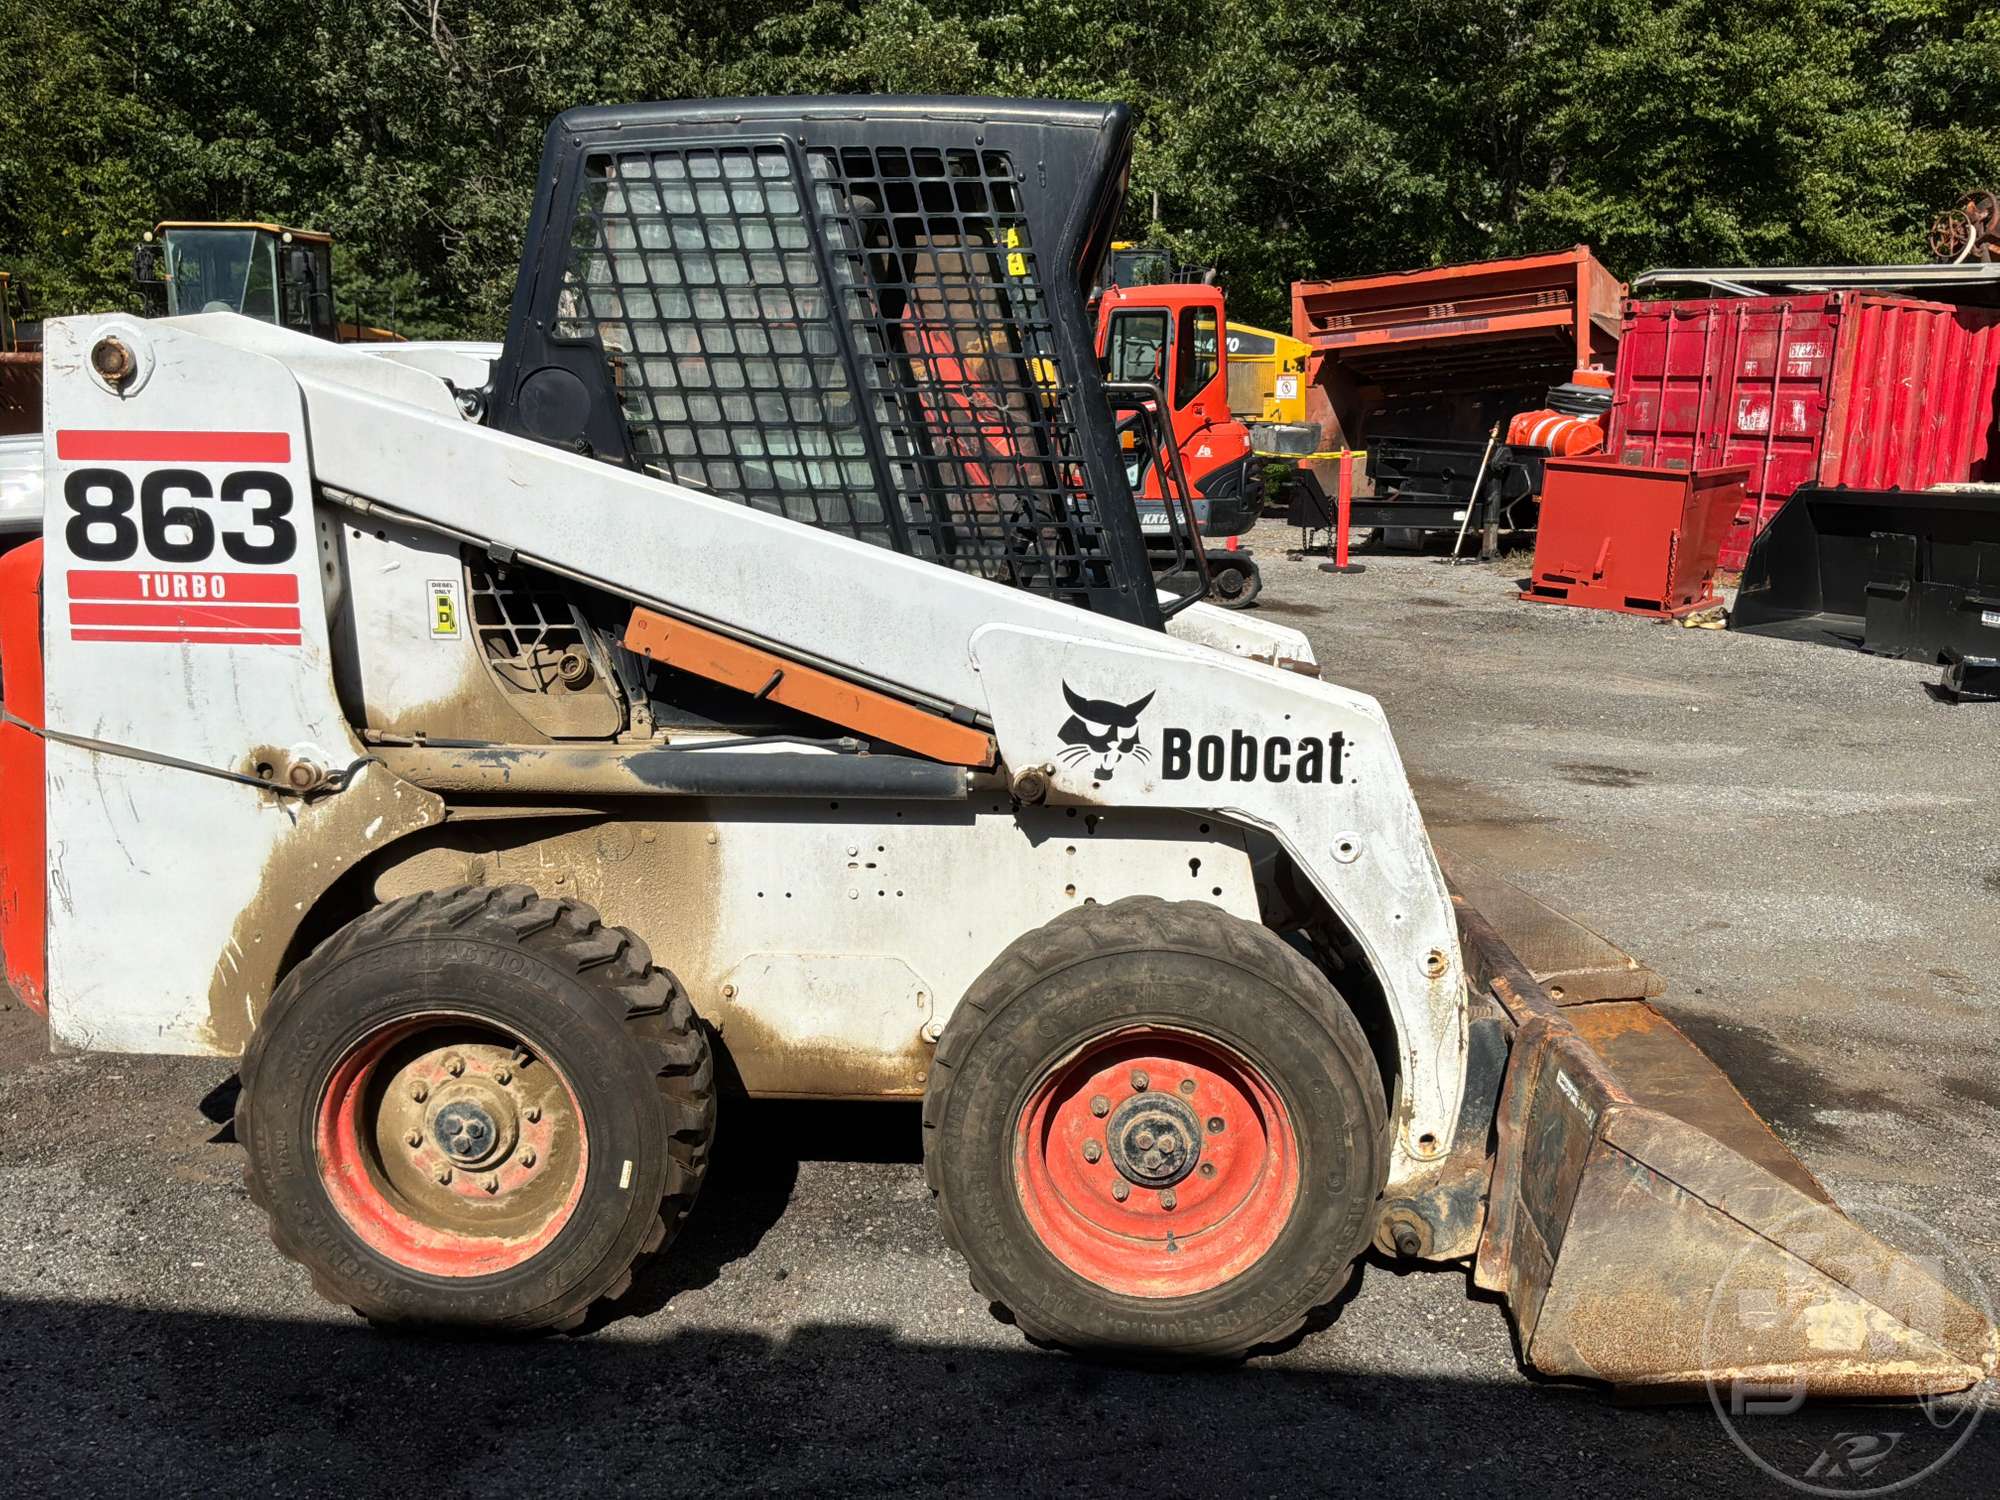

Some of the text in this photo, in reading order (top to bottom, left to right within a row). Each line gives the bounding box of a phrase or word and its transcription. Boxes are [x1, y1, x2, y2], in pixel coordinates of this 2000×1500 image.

[64, 468, 297, 565] 863
[138, 574, 226, 599] TURBO
[440, 612, 449, 623] D
[1162, 727, 1345, 785] Bobcat
